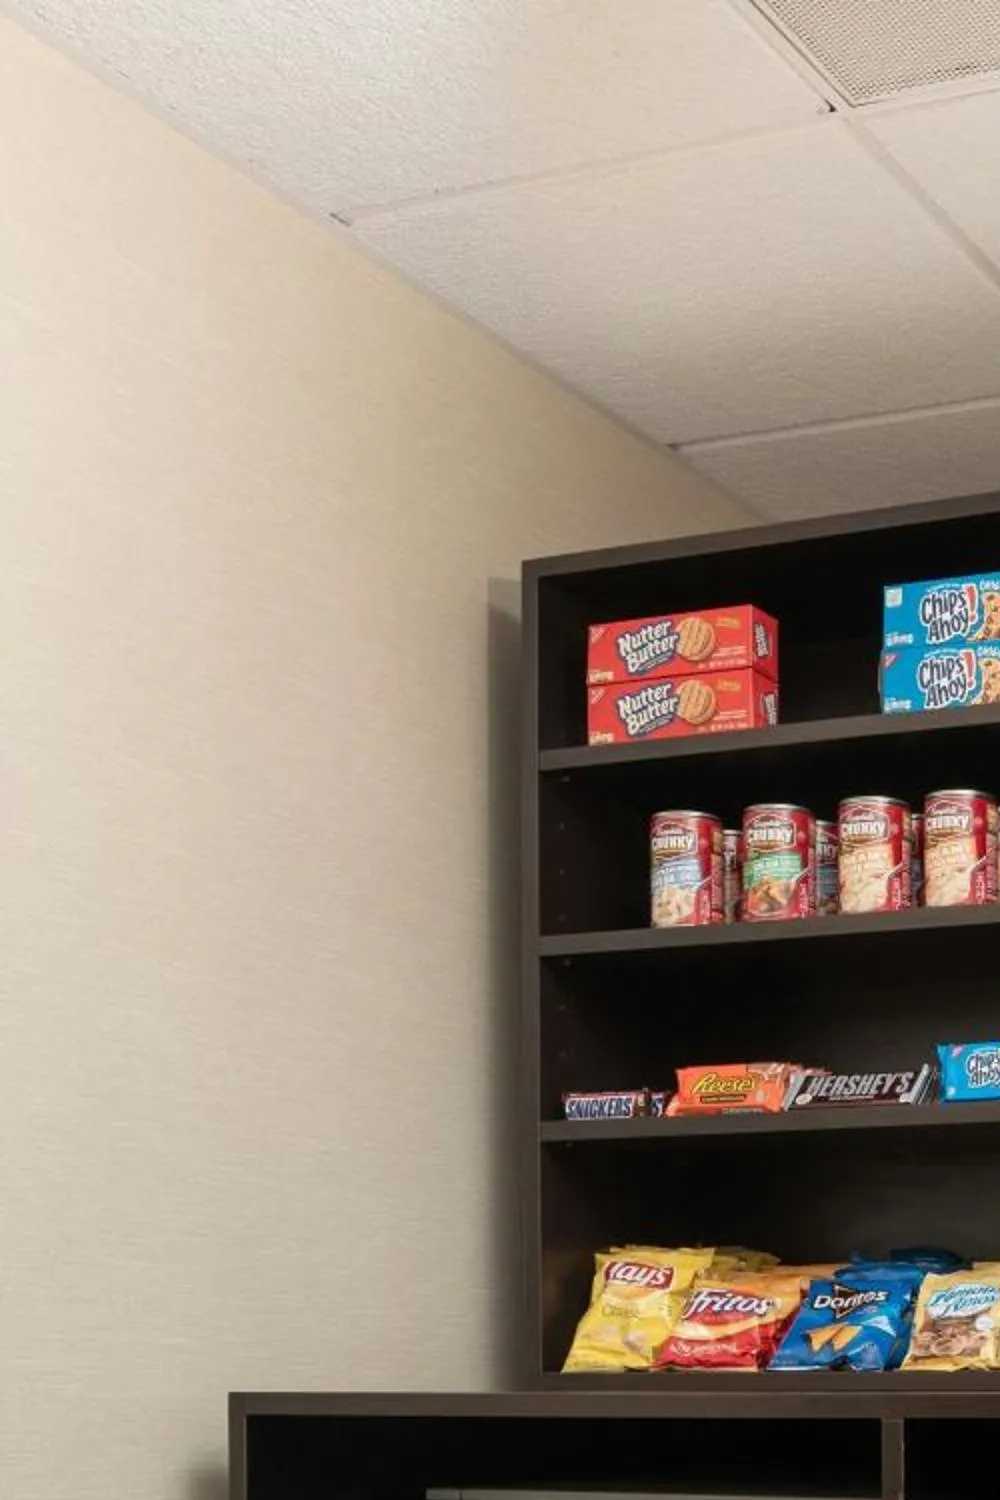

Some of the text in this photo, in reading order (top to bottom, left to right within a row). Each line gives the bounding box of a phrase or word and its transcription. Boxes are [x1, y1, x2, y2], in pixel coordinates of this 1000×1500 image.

[617, 620, 672, 655] Nutter
[626, 634, 679, 673] Butter
[617, 683, 672, 718] Nutter
[626, 697, 679, 736] Butter
[808, 1071, 915, 1097] HERSHEY'S
[567, 1098, 632, 1117] SNICKERS
[813, 1289, 889, 1309] Doritos
